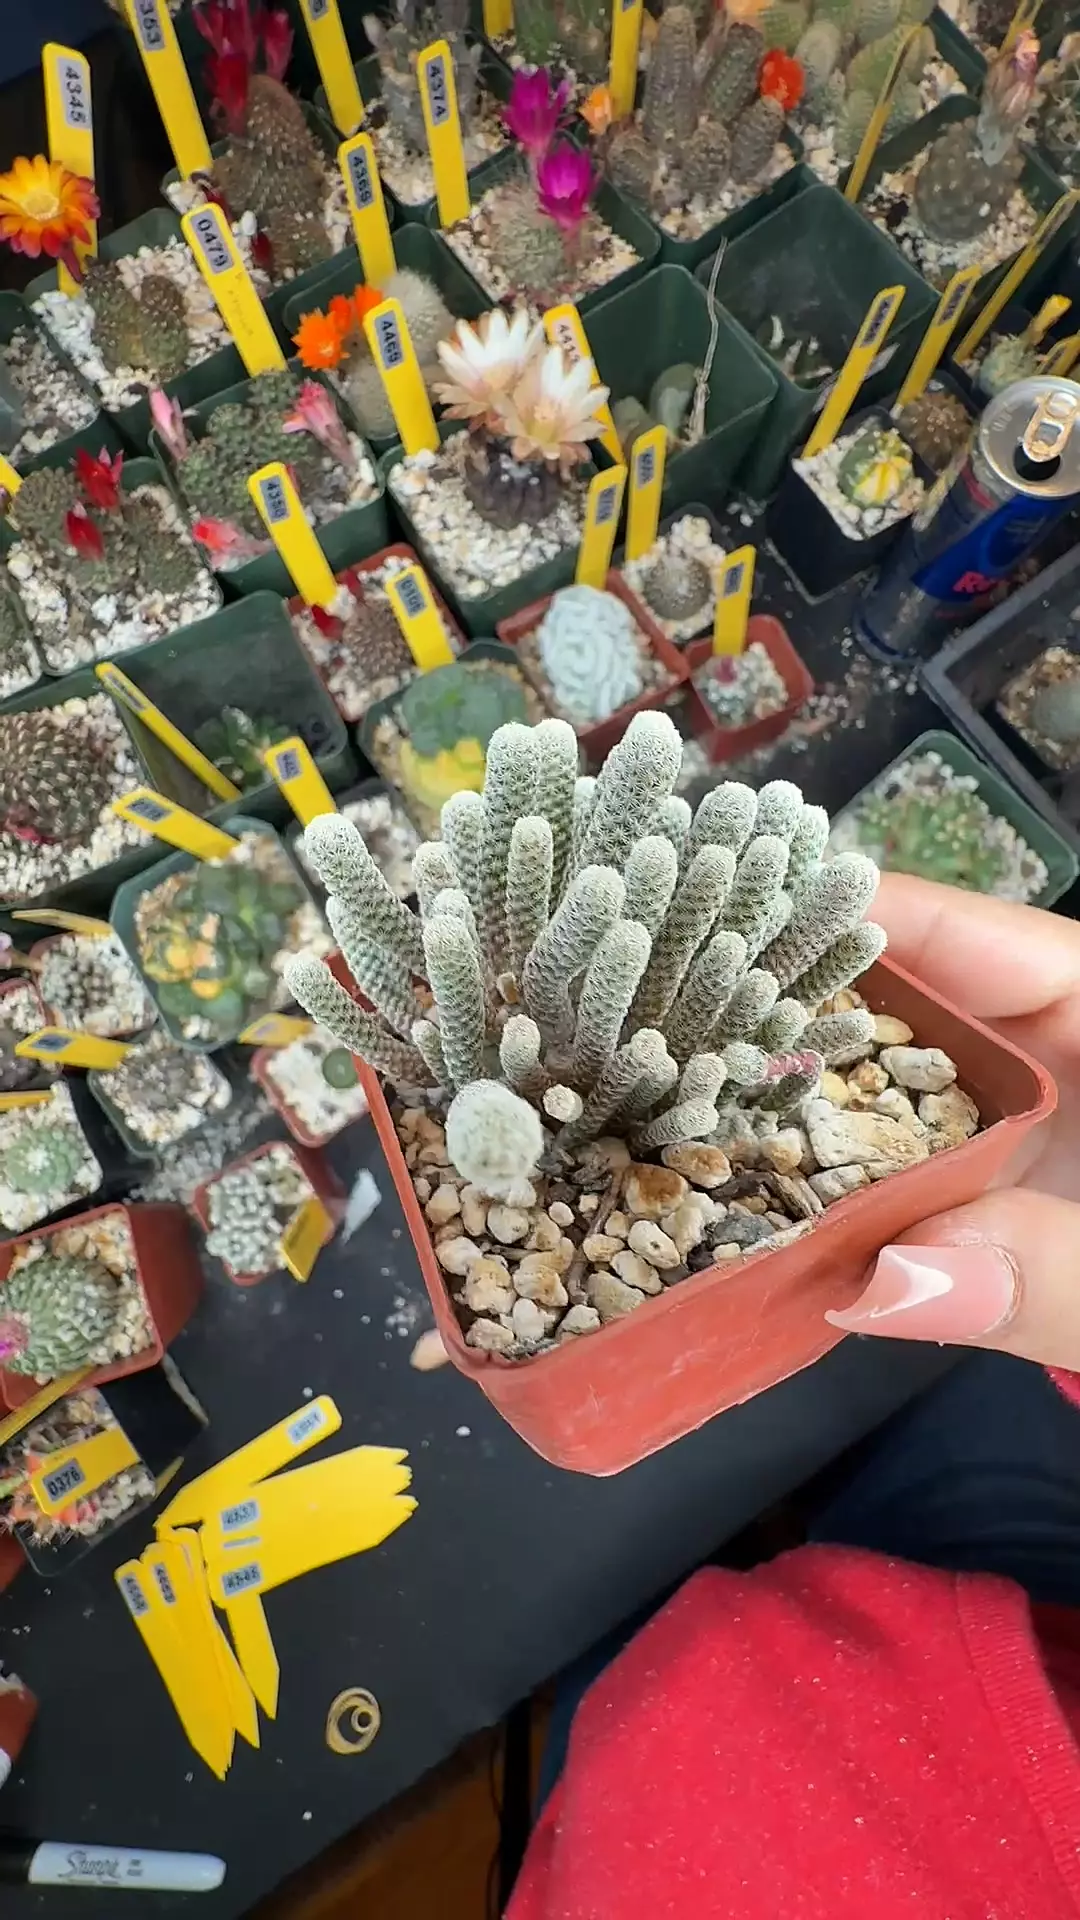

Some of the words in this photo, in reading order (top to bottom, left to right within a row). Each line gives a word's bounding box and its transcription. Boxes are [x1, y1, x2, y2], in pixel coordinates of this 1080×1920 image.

[65, 66, 86, 124] 4345
[196, 218, 229, 268] 0479
[48, 1466, 81, 1497] 0376
